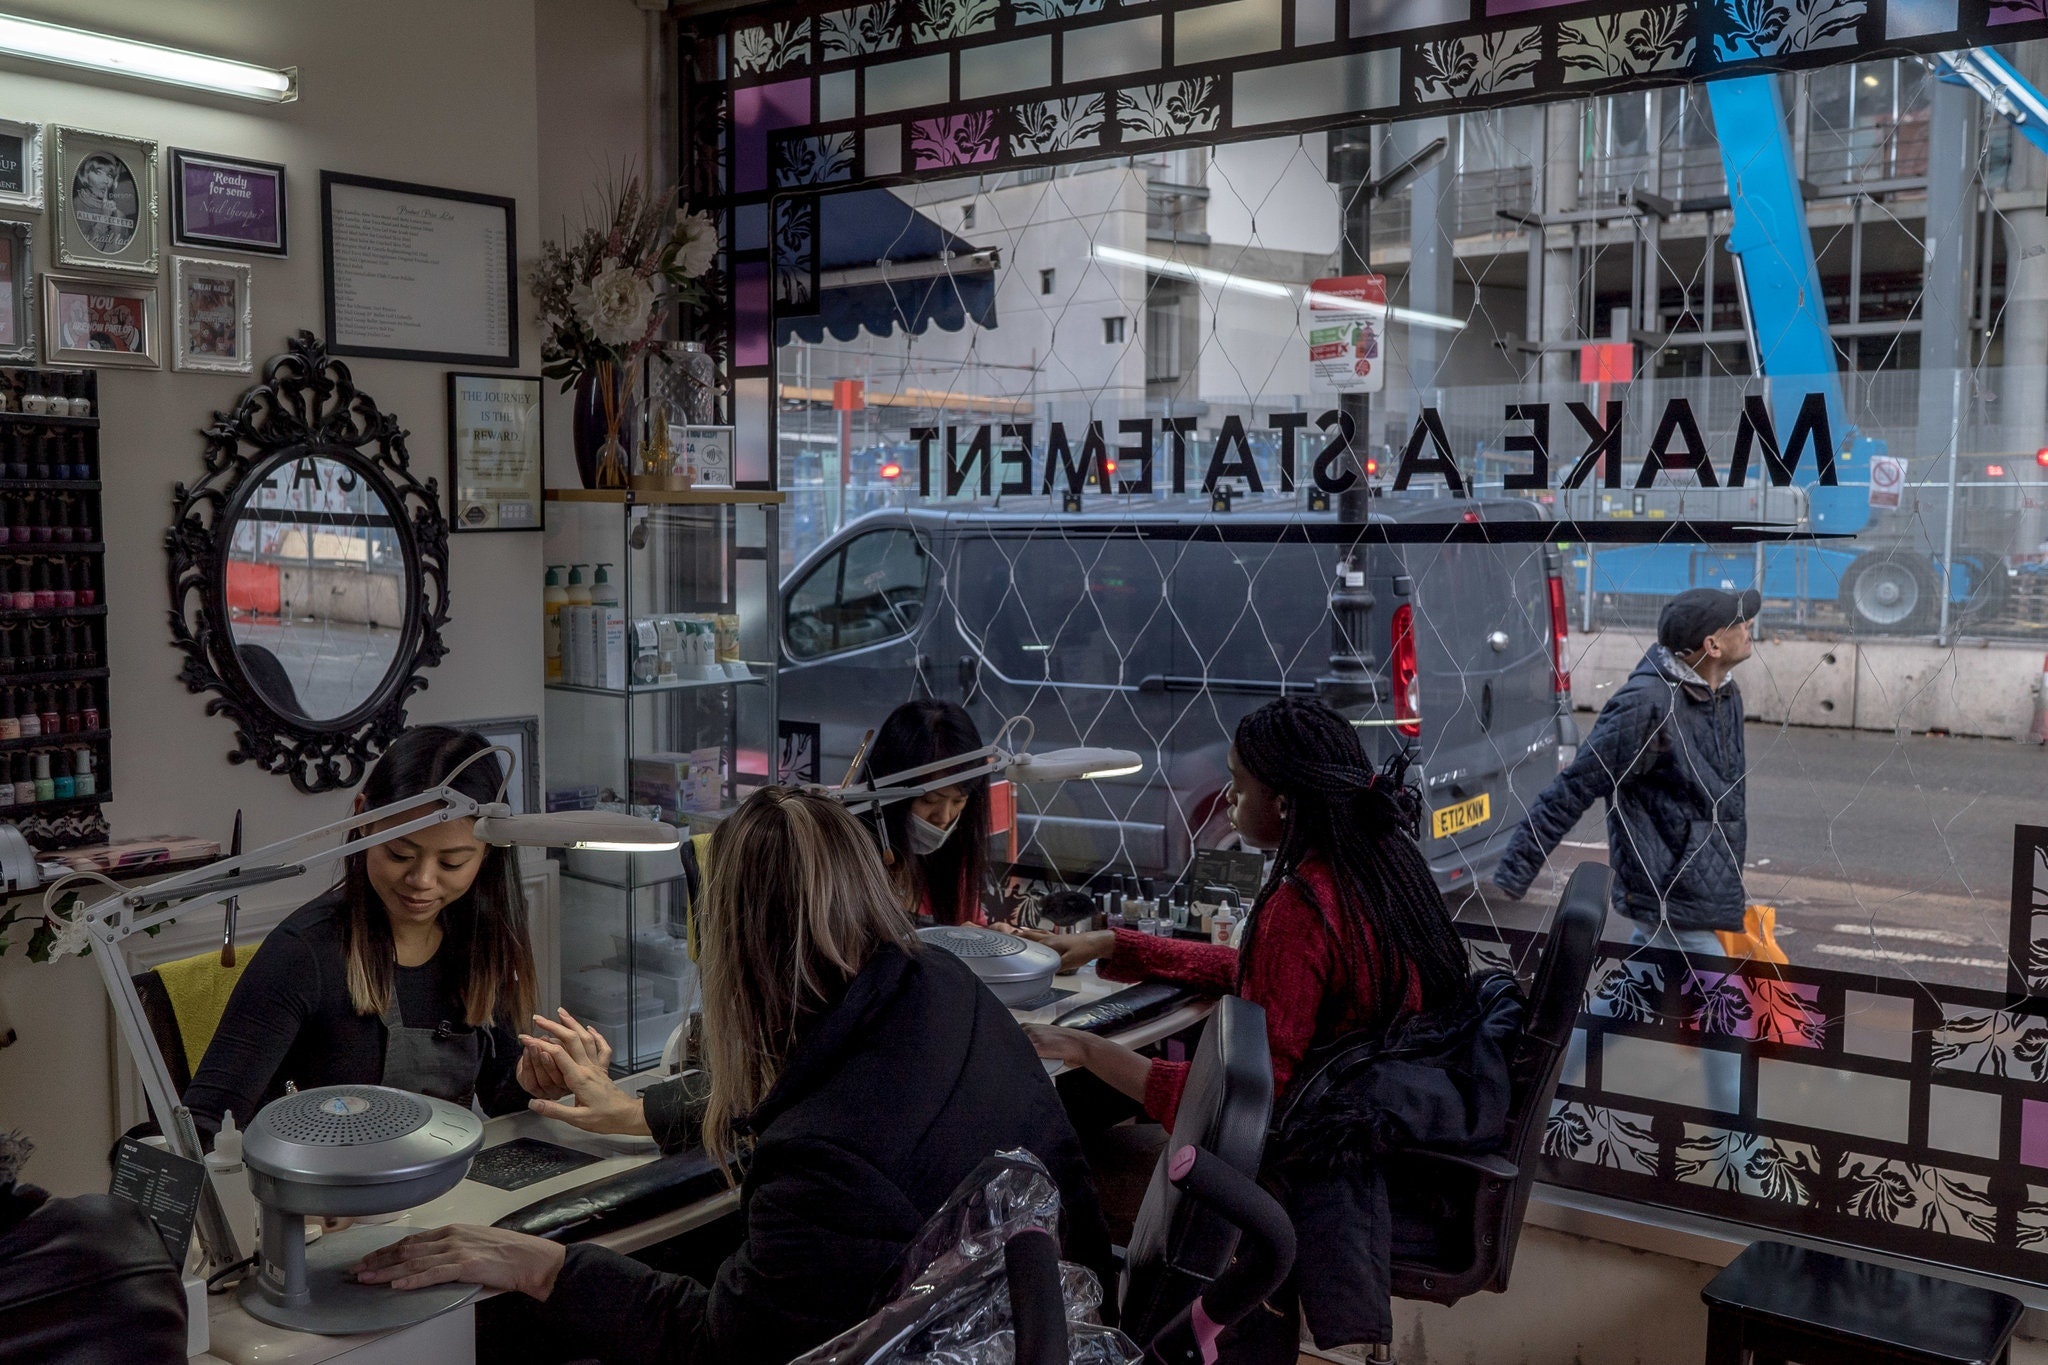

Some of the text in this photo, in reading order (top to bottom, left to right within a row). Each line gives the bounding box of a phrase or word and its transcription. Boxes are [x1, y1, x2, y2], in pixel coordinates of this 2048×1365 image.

[0, 160, 17, 170] UP
[213, 171, 247, 190] Ready
[209, 181, 252, 199] for some
[200, 200, 228, 215] Nail
[77, 212, 133, 227] ALL MY SECRETS
[90, 295, 115, 310] YOU
[105, 323, 121, 333] PART
[461, 390, 531, 405] THE JOURNEY
[481, 411, 513, 422] IS THE
[473, 430, 520, 442] REWARD.
[711, 471, 726, 484] Pay
[1440, 798, 1484, 832] ET12 KNW
